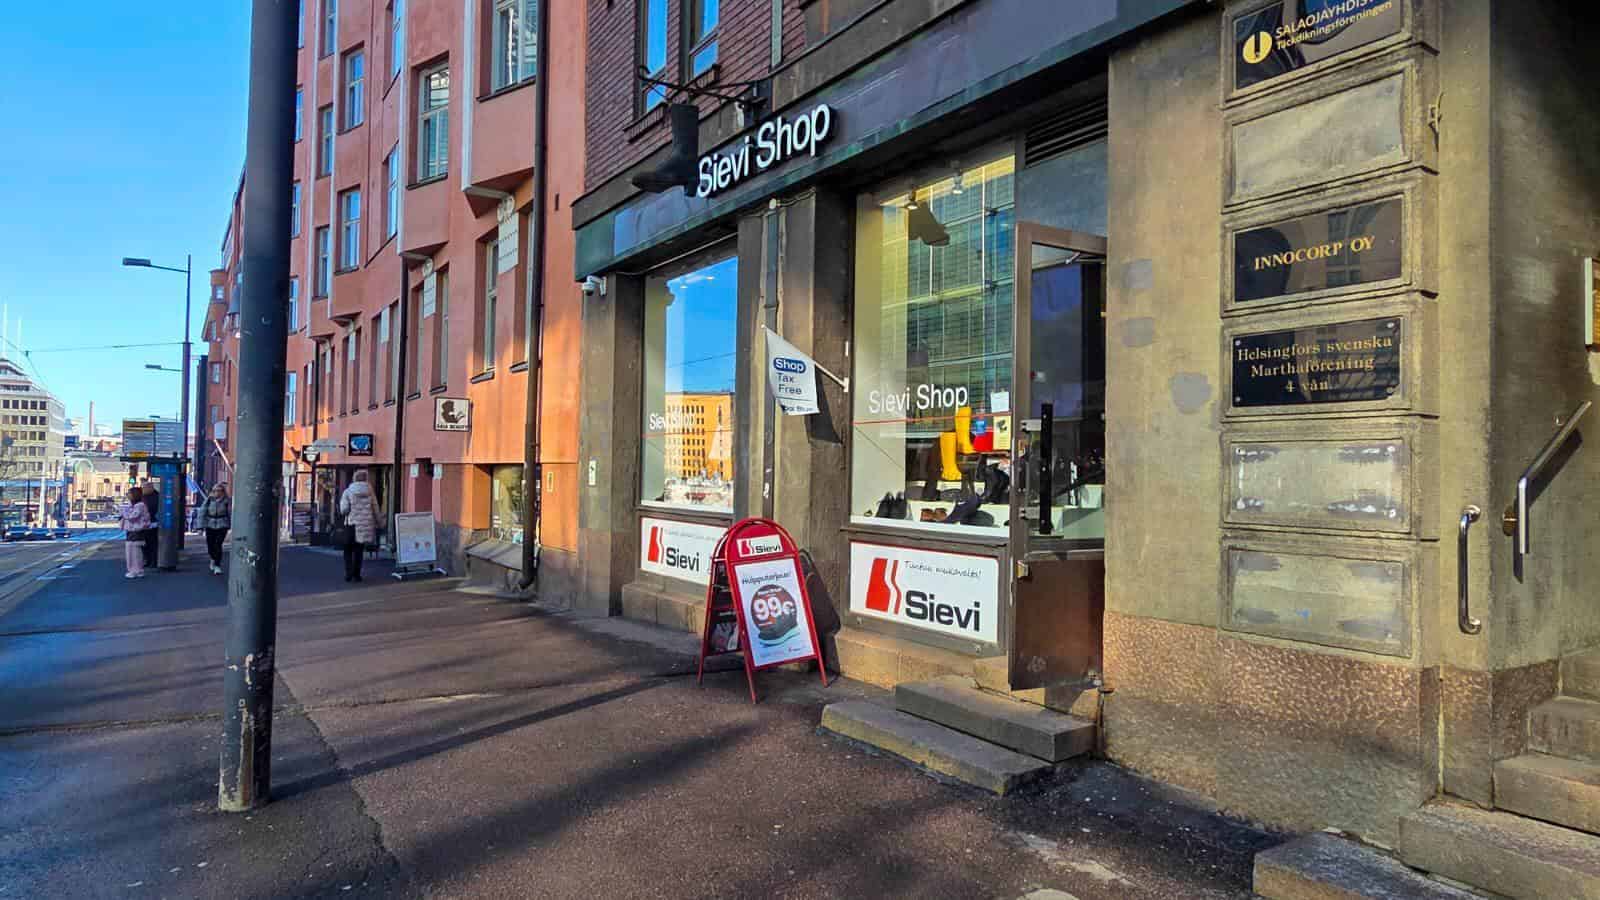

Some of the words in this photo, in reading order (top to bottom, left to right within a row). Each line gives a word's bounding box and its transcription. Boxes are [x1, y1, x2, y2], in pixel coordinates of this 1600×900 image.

[697, 136, 750, 197] Sievi
[756, 104, 830, 168] Shop
[1254, 241, 1343, 271] INNOCORP
[1350, 234, 1376, 252] OY
[1238, 343, 1321, 361] Helsingfors
[1327, 336, 1393, 354] svenska
[775, 358, 804, 373] Shop
[776, 372, 795, 383] Tax
[1251, 356, 1375, 377] Marthaförening
[778, 383, 802, 395] Free
[868, 387, 911, 414] Sievi
[916, 383, 968, 414] Shop
[1286, 380, 1295, 393] 4
[666, 547, 700, 572] Sievi
[905, 589, 981, 633] Sievi
